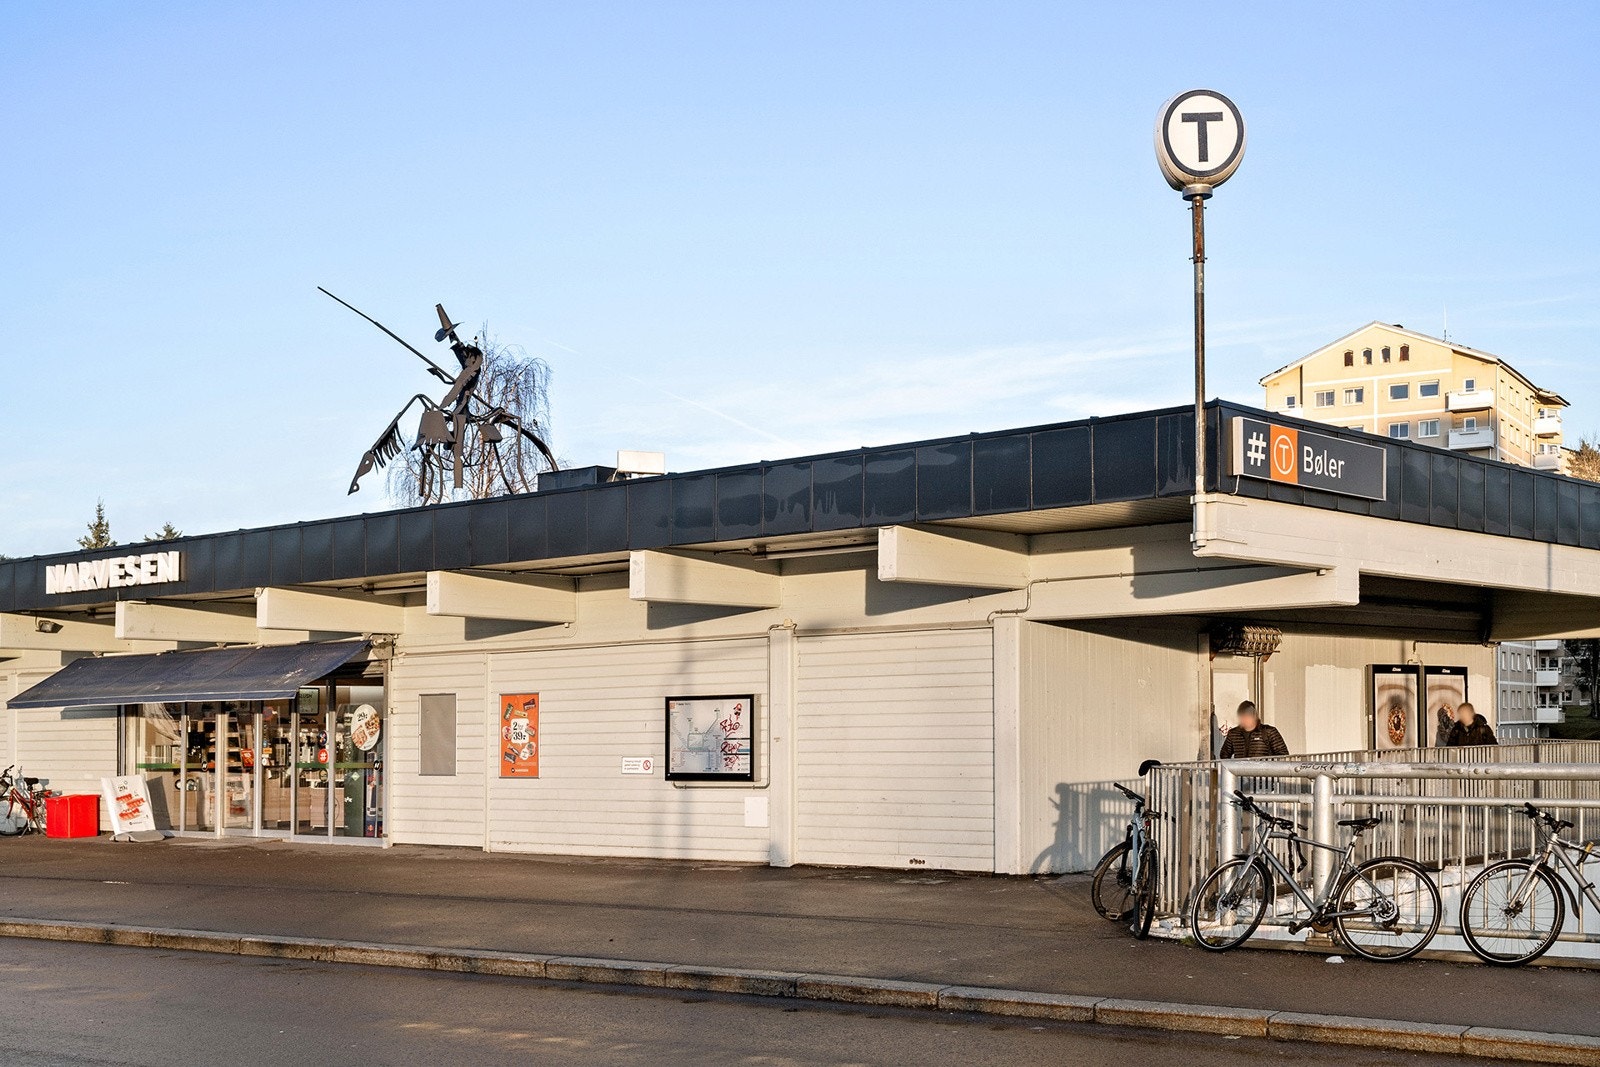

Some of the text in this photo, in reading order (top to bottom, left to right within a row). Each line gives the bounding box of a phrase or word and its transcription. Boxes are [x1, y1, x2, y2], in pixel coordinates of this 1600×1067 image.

[1181, 112, 1223, 162] T
[1303, 445, 1346, 479] Bøler
[45, 551, 181, 595] NARVESEN
[512, 721, 518, 731] 2
